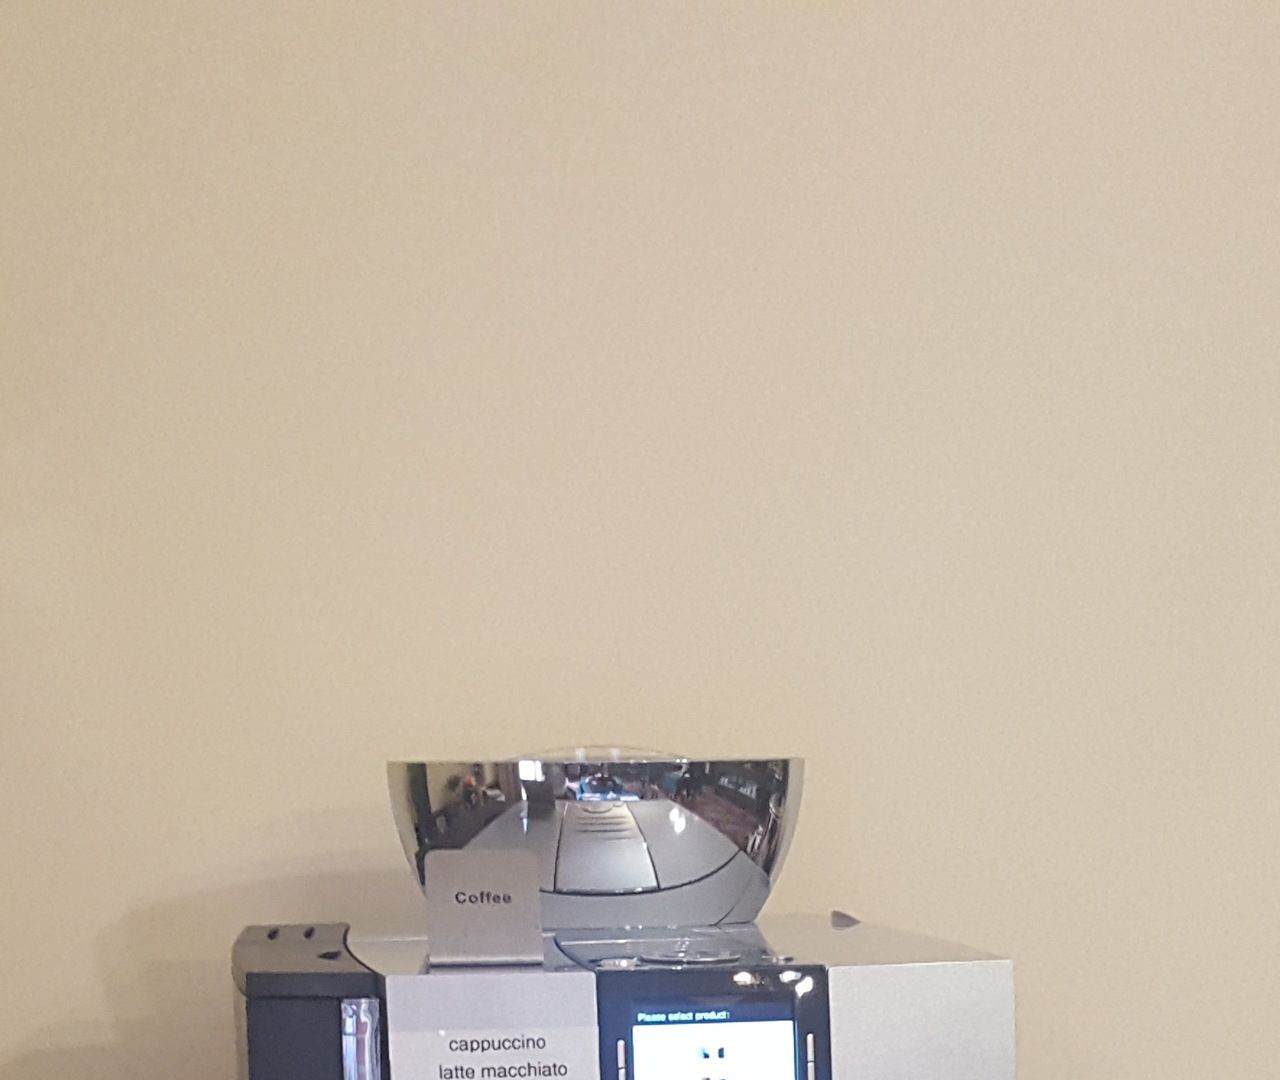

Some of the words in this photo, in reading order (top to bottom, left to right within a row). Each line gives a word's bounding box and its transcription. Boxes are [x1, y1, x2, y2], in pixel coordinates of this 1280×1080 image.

[455, 890, 513, 904] Coffee
[448, 1034, 547, 1053] cappuccino
[438, 1064, 475, 1080] latte
[481, 1061, 568, 1079] macchiato
